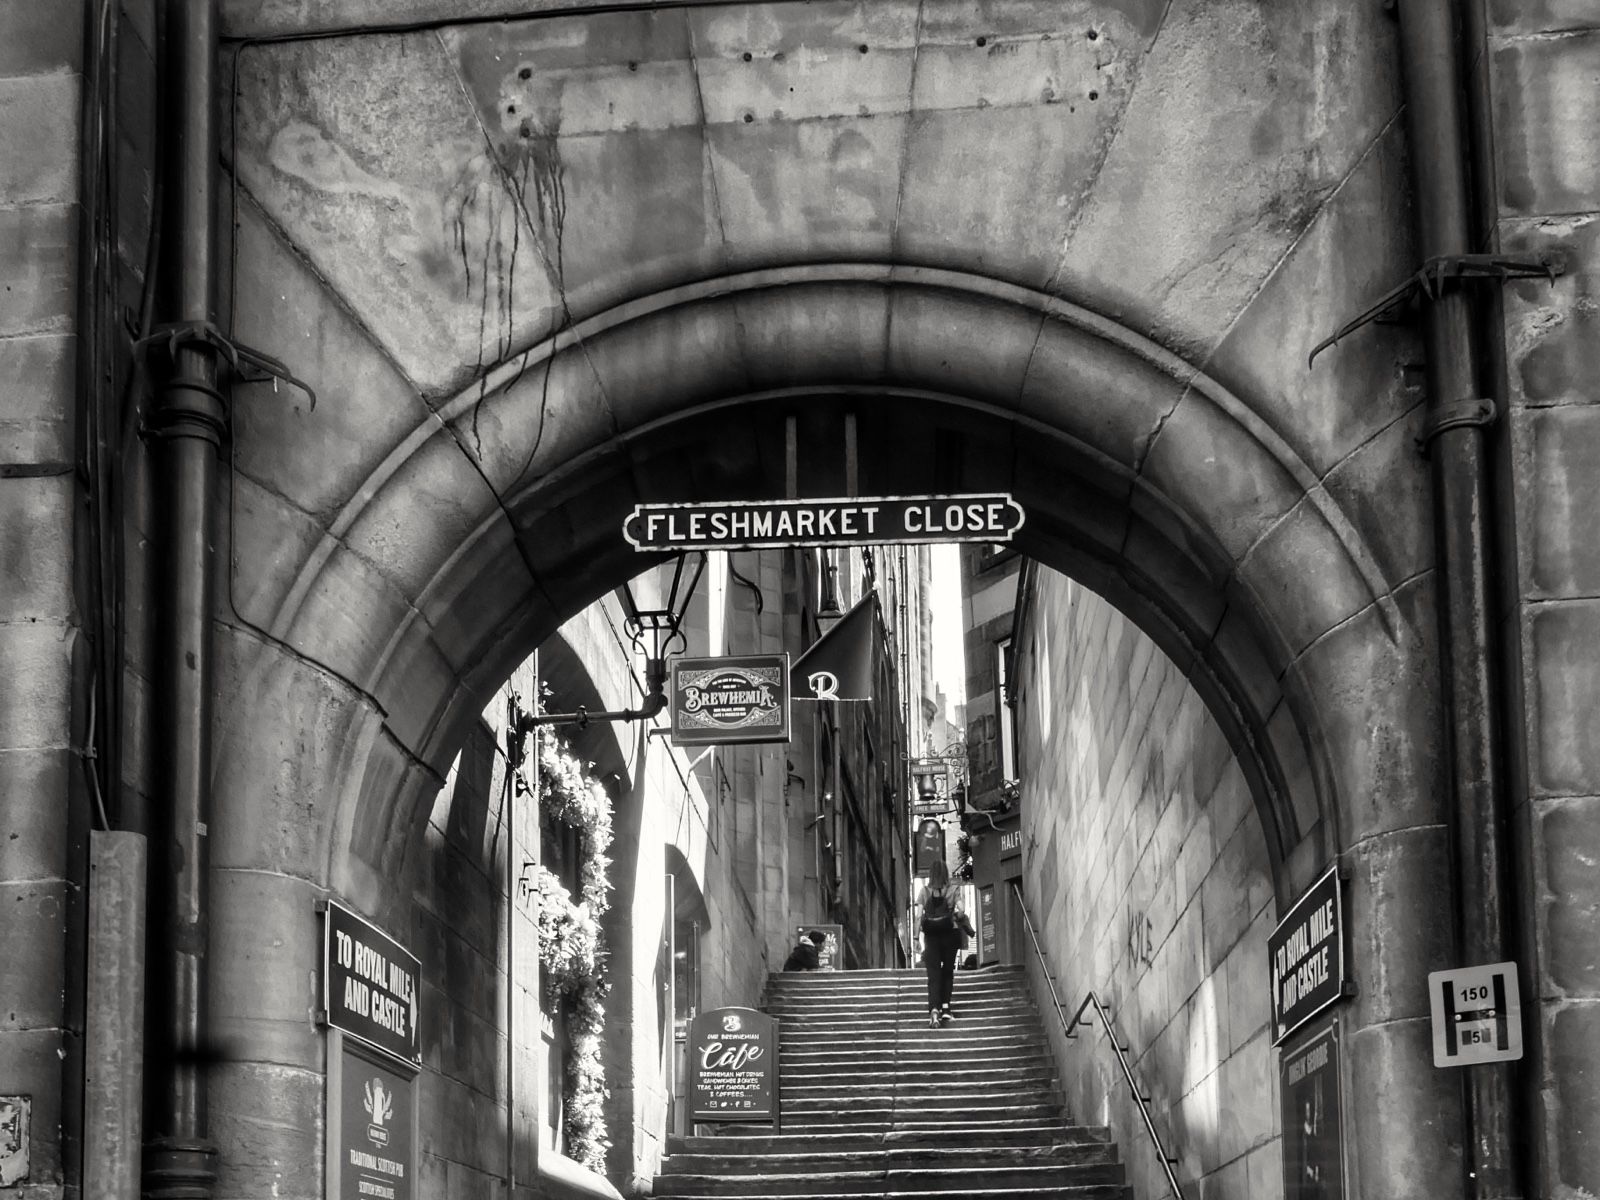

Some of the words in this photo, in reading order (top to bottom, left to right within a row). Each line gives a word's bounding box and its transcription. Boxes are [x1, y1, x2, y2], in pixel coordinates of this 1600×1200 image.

[647, 507, 879, 541] FLESHMARKET
[904, 504, 1004, 533] CLOSE
[685, 685, 777, 712] BREWHEMIA
[336, 930, 352, 968] TO
[355, 941, 388, 990] ROYAL
[390, 962, 410, 1004] MILE
[1277, 945, 1286, 980] TO
[1286, 922, 1309, 971] ROYAL
[1310, 898, 1334, 949] MILE
[344, 976, 369, 1017] AND
[372, 990, 405, 1037] CASTLE
[1283, 974, 1297, 1014] AND
[1298, 946, 1328, 1000] CASTLE
[1461, 986, 1488, 1001] 150
